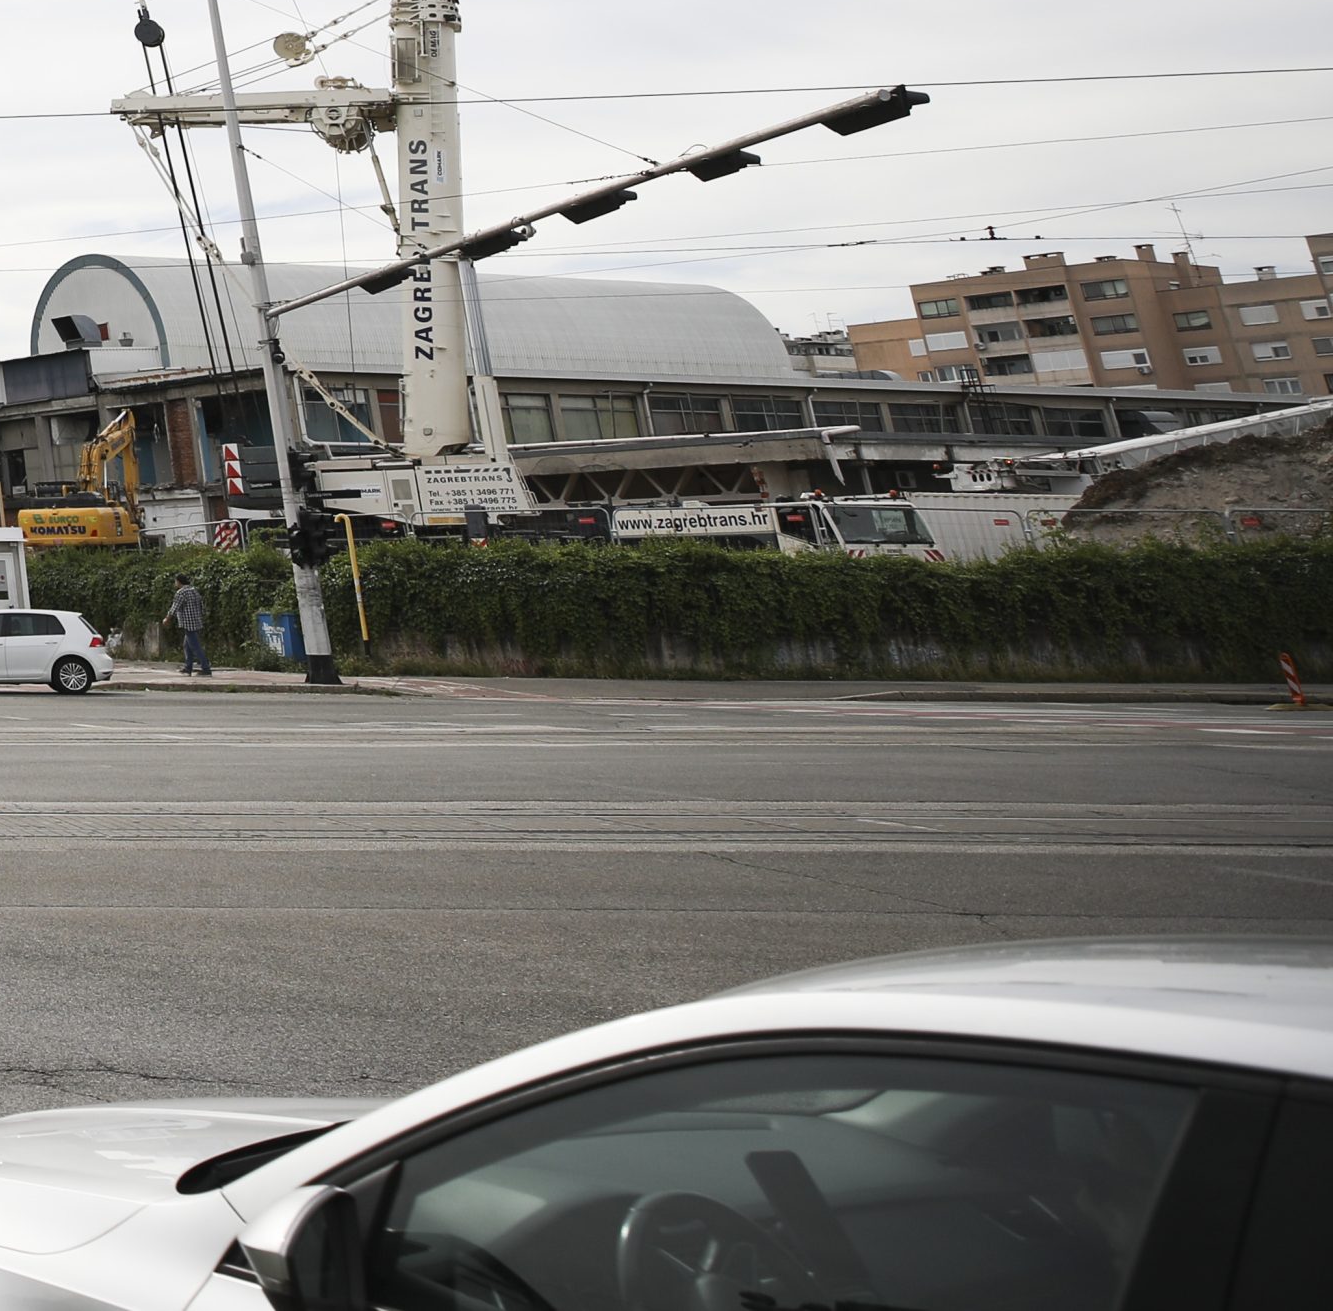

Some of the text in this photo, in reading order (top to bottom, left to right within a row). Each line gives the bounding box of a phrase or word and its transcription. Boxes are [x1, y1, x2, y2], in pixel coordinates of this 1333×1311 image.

[408, 139, 434, 361] ZAGRE TRANS
[426, 475, 503, 484] ZAGREBTRANS
[428, 490, 441, 498] Tel.
[617, 511, 768, 532] www.zagrebtrans.hr
[30, 525, 86, 535] KOMATSU
